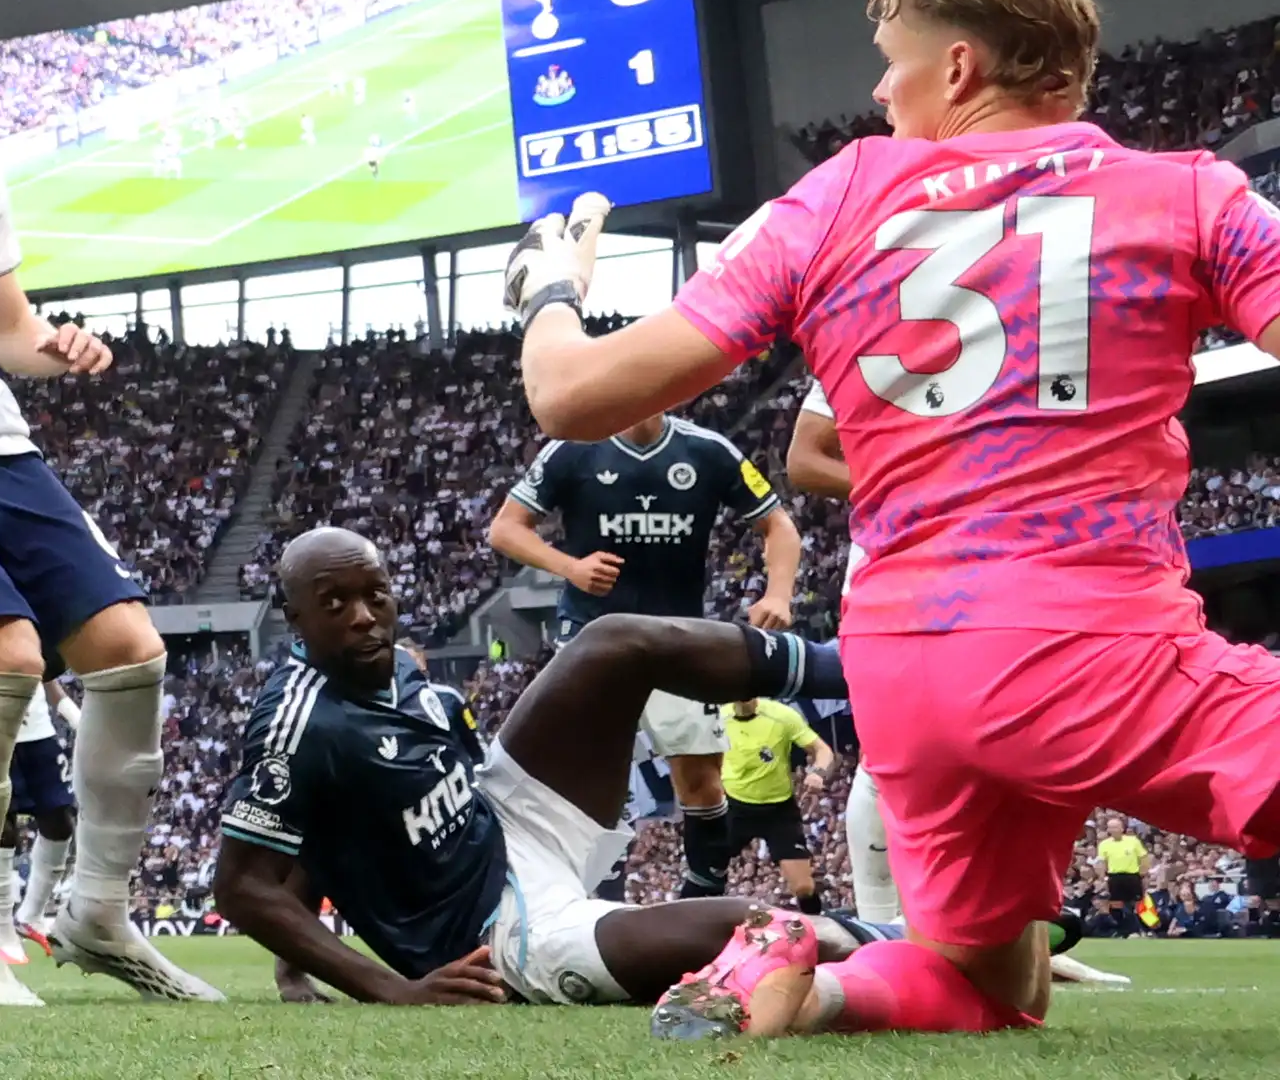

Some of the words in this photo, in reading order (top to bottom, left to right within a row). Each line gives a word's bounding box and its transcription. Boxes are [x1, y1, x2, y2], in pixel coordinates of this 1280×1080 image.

[627, 48, 655, 85] 1
[856, 195, 1096, 417] 31
[402, 760, 474, 847] KNO
